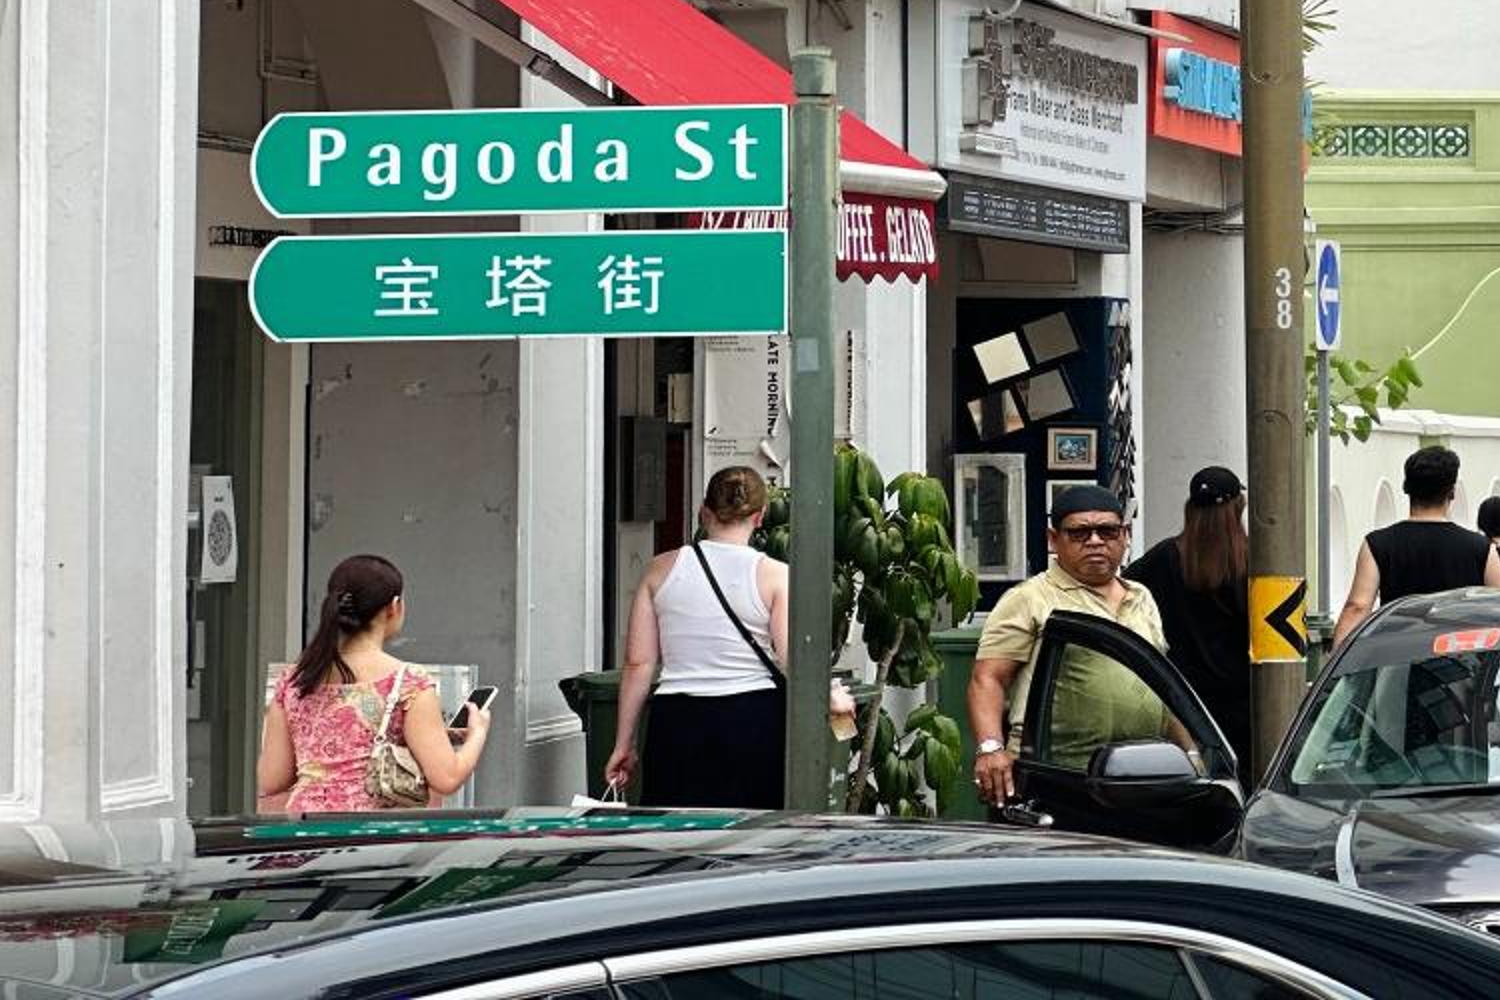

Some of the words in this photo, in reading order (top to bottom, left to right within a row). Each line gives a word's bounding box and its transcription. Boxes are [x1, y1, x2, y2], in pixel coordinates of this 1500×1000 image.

[305, 122, 630, 201] Pagoda
[674, 120, 760, 181] St
[837, 203, 877, 262] OFFEE
[886, 205, 935, 264] GELATO
[373, 254, 665, 317] 宝塔街
[1275, 267, 1292, 329] 38
